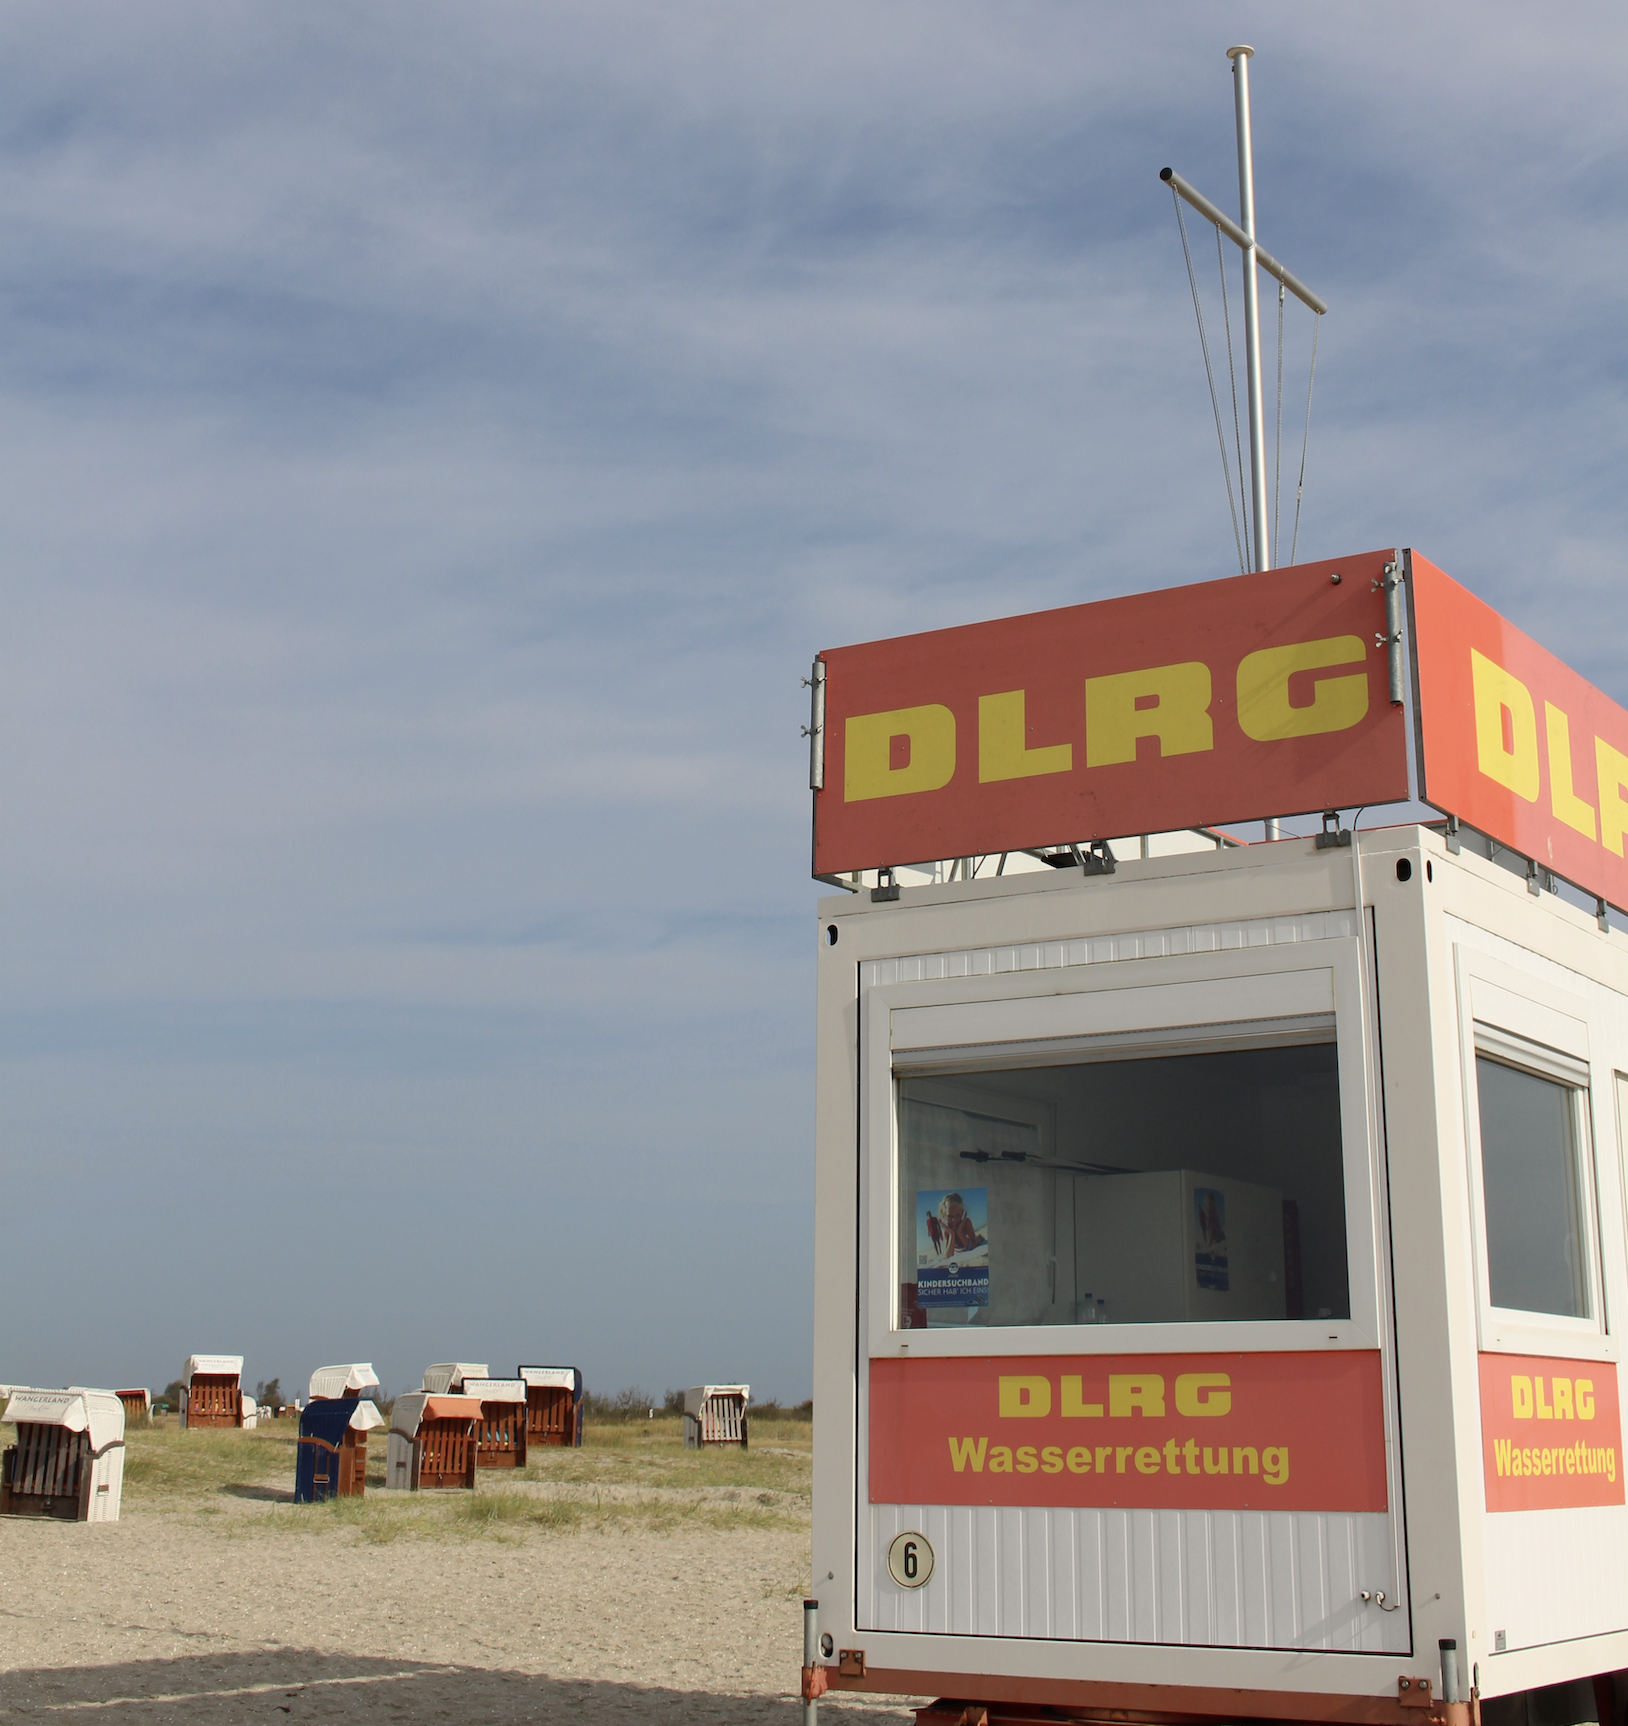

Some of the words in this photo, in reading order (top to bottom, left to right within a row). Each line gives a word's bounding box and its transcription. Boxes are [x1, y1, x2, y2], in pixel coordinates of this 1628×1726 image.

[844, 634, 1369, 803] DLRG
[917, 1288, 942, 1296] SICHER
[960, 1287, 972, 1295] ICH
[918, 1278, 989, 1288] KINDERSUCHBAND
[15, 1395, 70, 1404] WANGERLAND
[999, 1373, 1232, 1417] DLRG
[1511, 1375, 1595, 1420] DLRG
[948, 1437, 1290, 1485] Wasserrettung
[1494, 1439, 1616, 1483] Wasserrettung
[904, 1541, 917, 1578] 6
